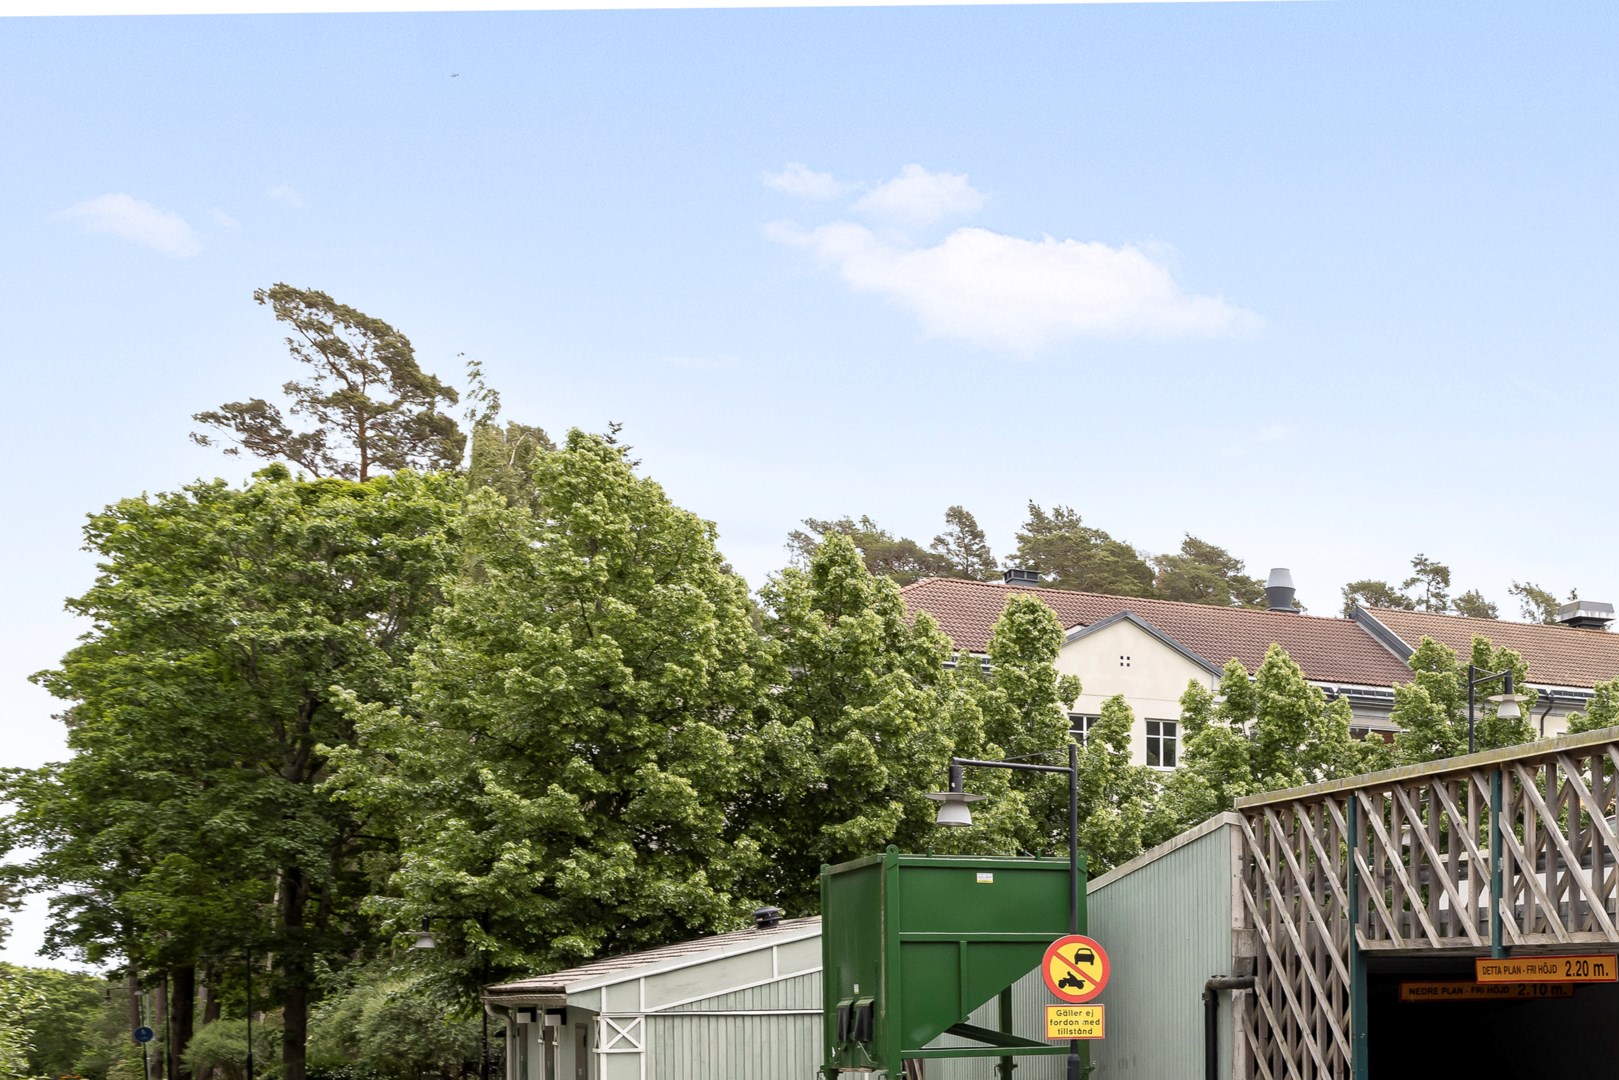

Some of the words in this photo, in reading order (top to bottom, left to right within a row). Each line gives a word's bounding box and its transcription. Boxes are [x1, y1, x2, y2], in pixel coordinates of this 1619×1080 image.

[1482, 965, 1501, 975] DETTA
[1503, 965, 1521, 974] PLAN
[1526, 964, 1537, 973] FRI
[1538, 962, 1557, 974] HÖJD
[1564, 960, 1589, 977] 2.20
[1593, 962, 1609, 976] m.
[1409, 987, 1438, 996] NEDRE
[1441, 986, 1463, 995] PLAN
[1470, 986, 1485, 994] FRI
[1487, 984, 1509, 994] HÖJD
[1517, 983, 1547, 996] 2.10
[1551, 984, 1567, 995] m.
